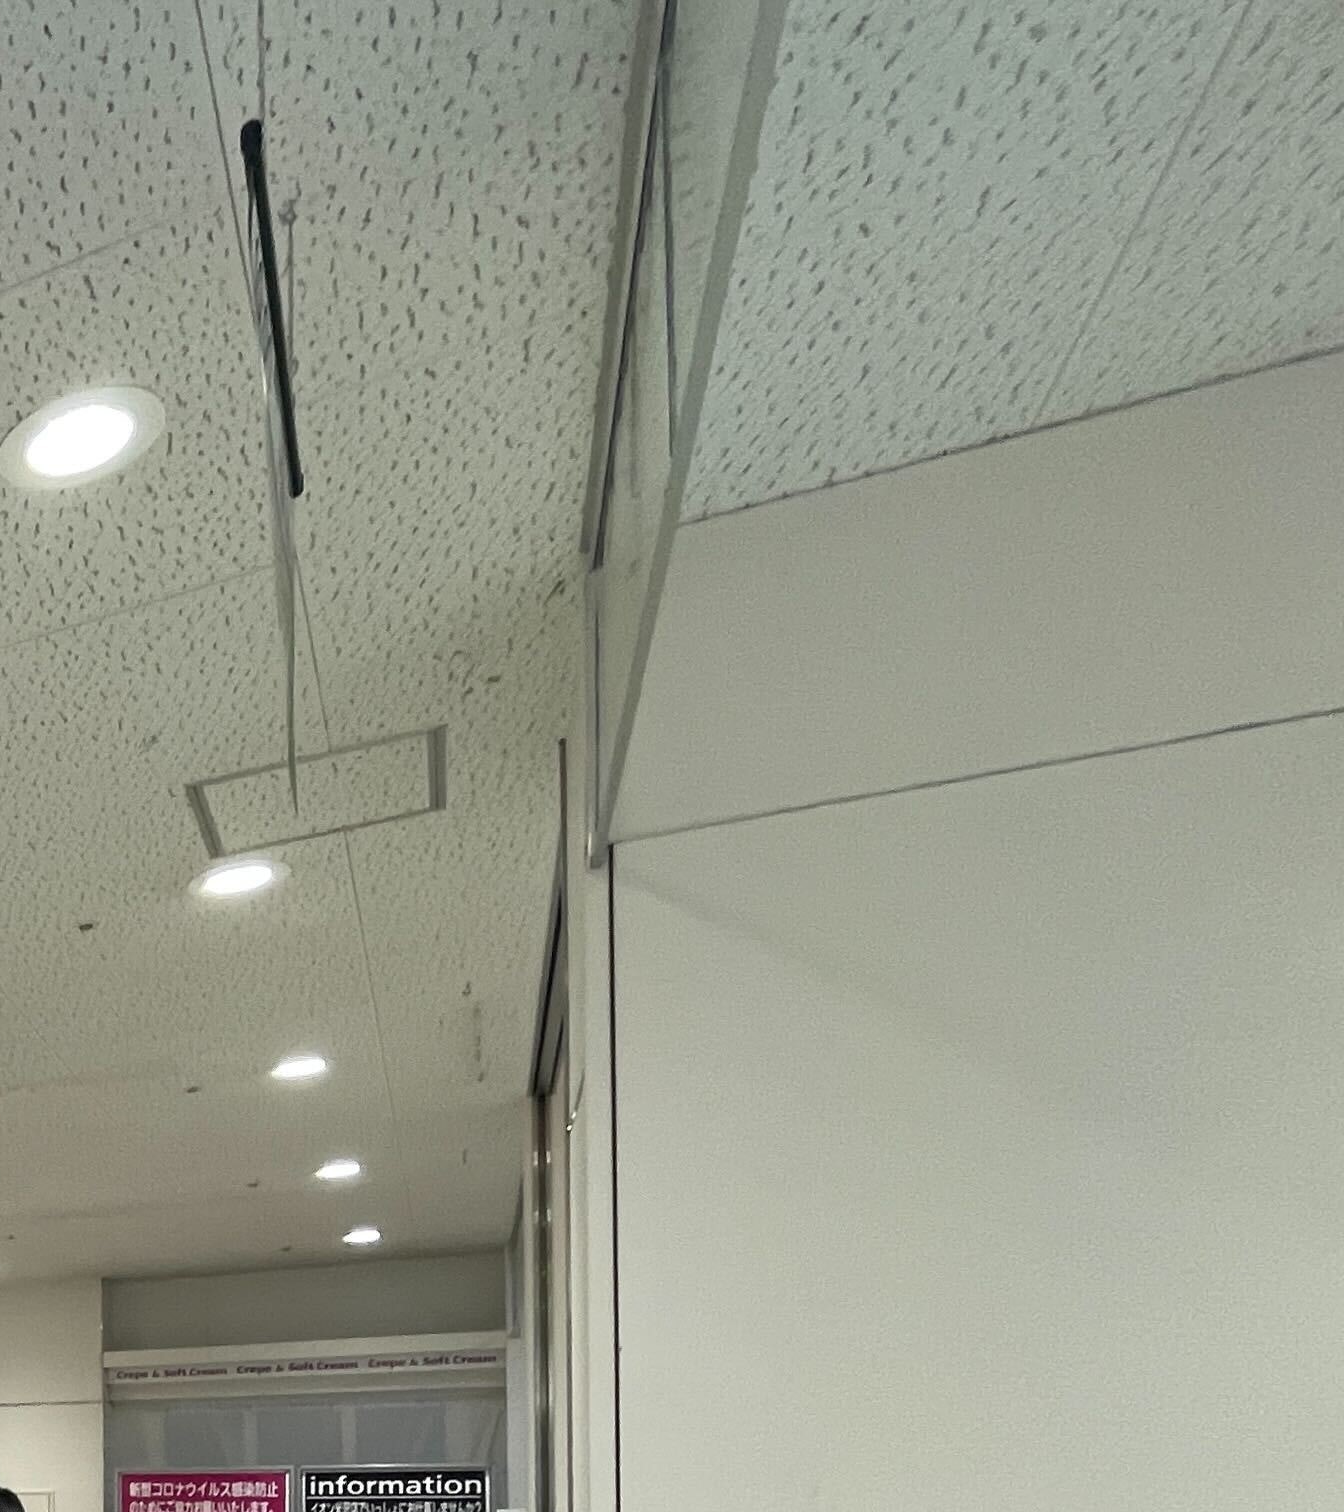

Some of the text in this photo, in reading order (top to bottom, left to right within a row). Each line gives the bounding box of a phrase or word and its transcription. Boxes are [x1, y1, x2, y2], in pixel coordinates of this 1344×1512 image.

[129, 1481, 279, 1498] 新型コロナウイルス感染防止
[310, 1474, 482, 1496] information
